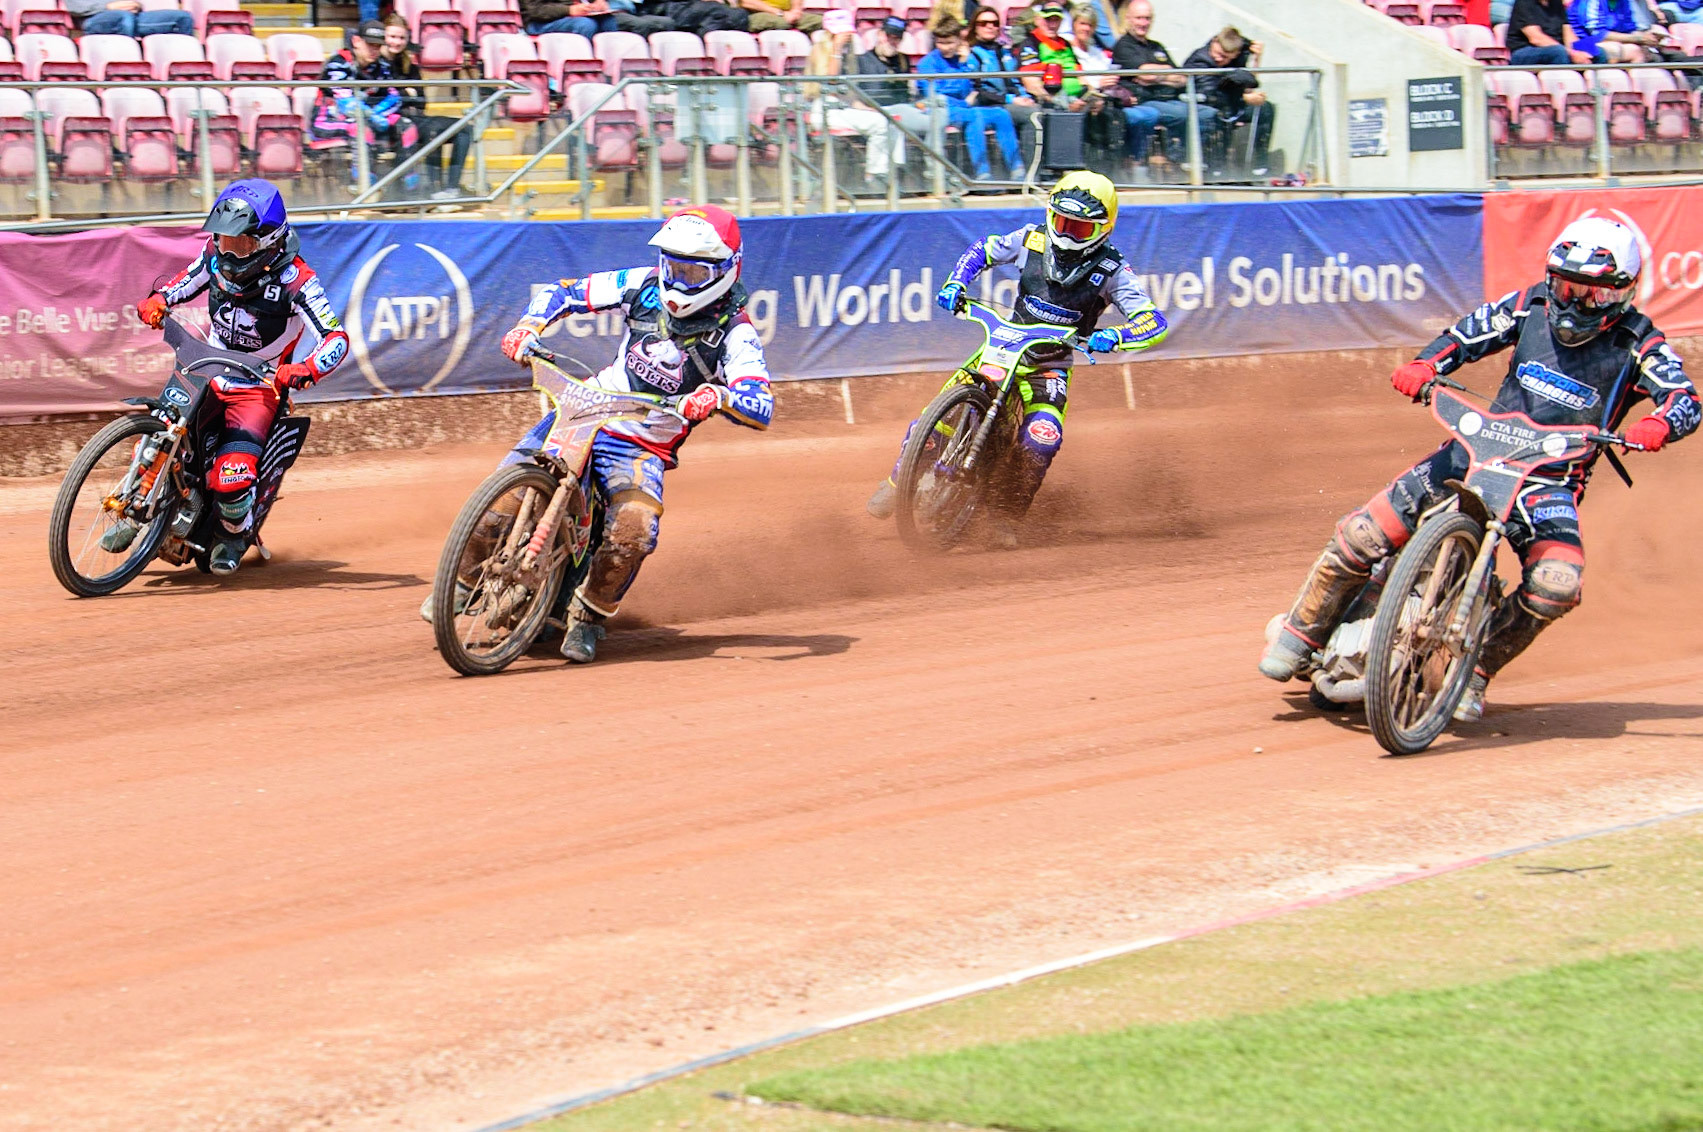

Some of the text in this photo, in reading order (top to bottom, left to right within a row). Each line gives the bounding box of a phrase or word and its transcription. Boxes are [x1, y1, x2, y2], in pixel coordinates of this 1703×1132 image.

[793, 267, 933, 327] World
[1228, 252, 1426, 308] Solutions
[16, 306, 71, 334] Belle
[74, 306, 119, 332] Vue
[368, 295, 450, 342] ATPI
[627, 353, 681, 394] COLTS
[1521, 374, 1585, 408] CHARGERS
[1480, 429, 1541, 451] DETECTION
[1491, 421, 1537, 439] CTA FIRE
